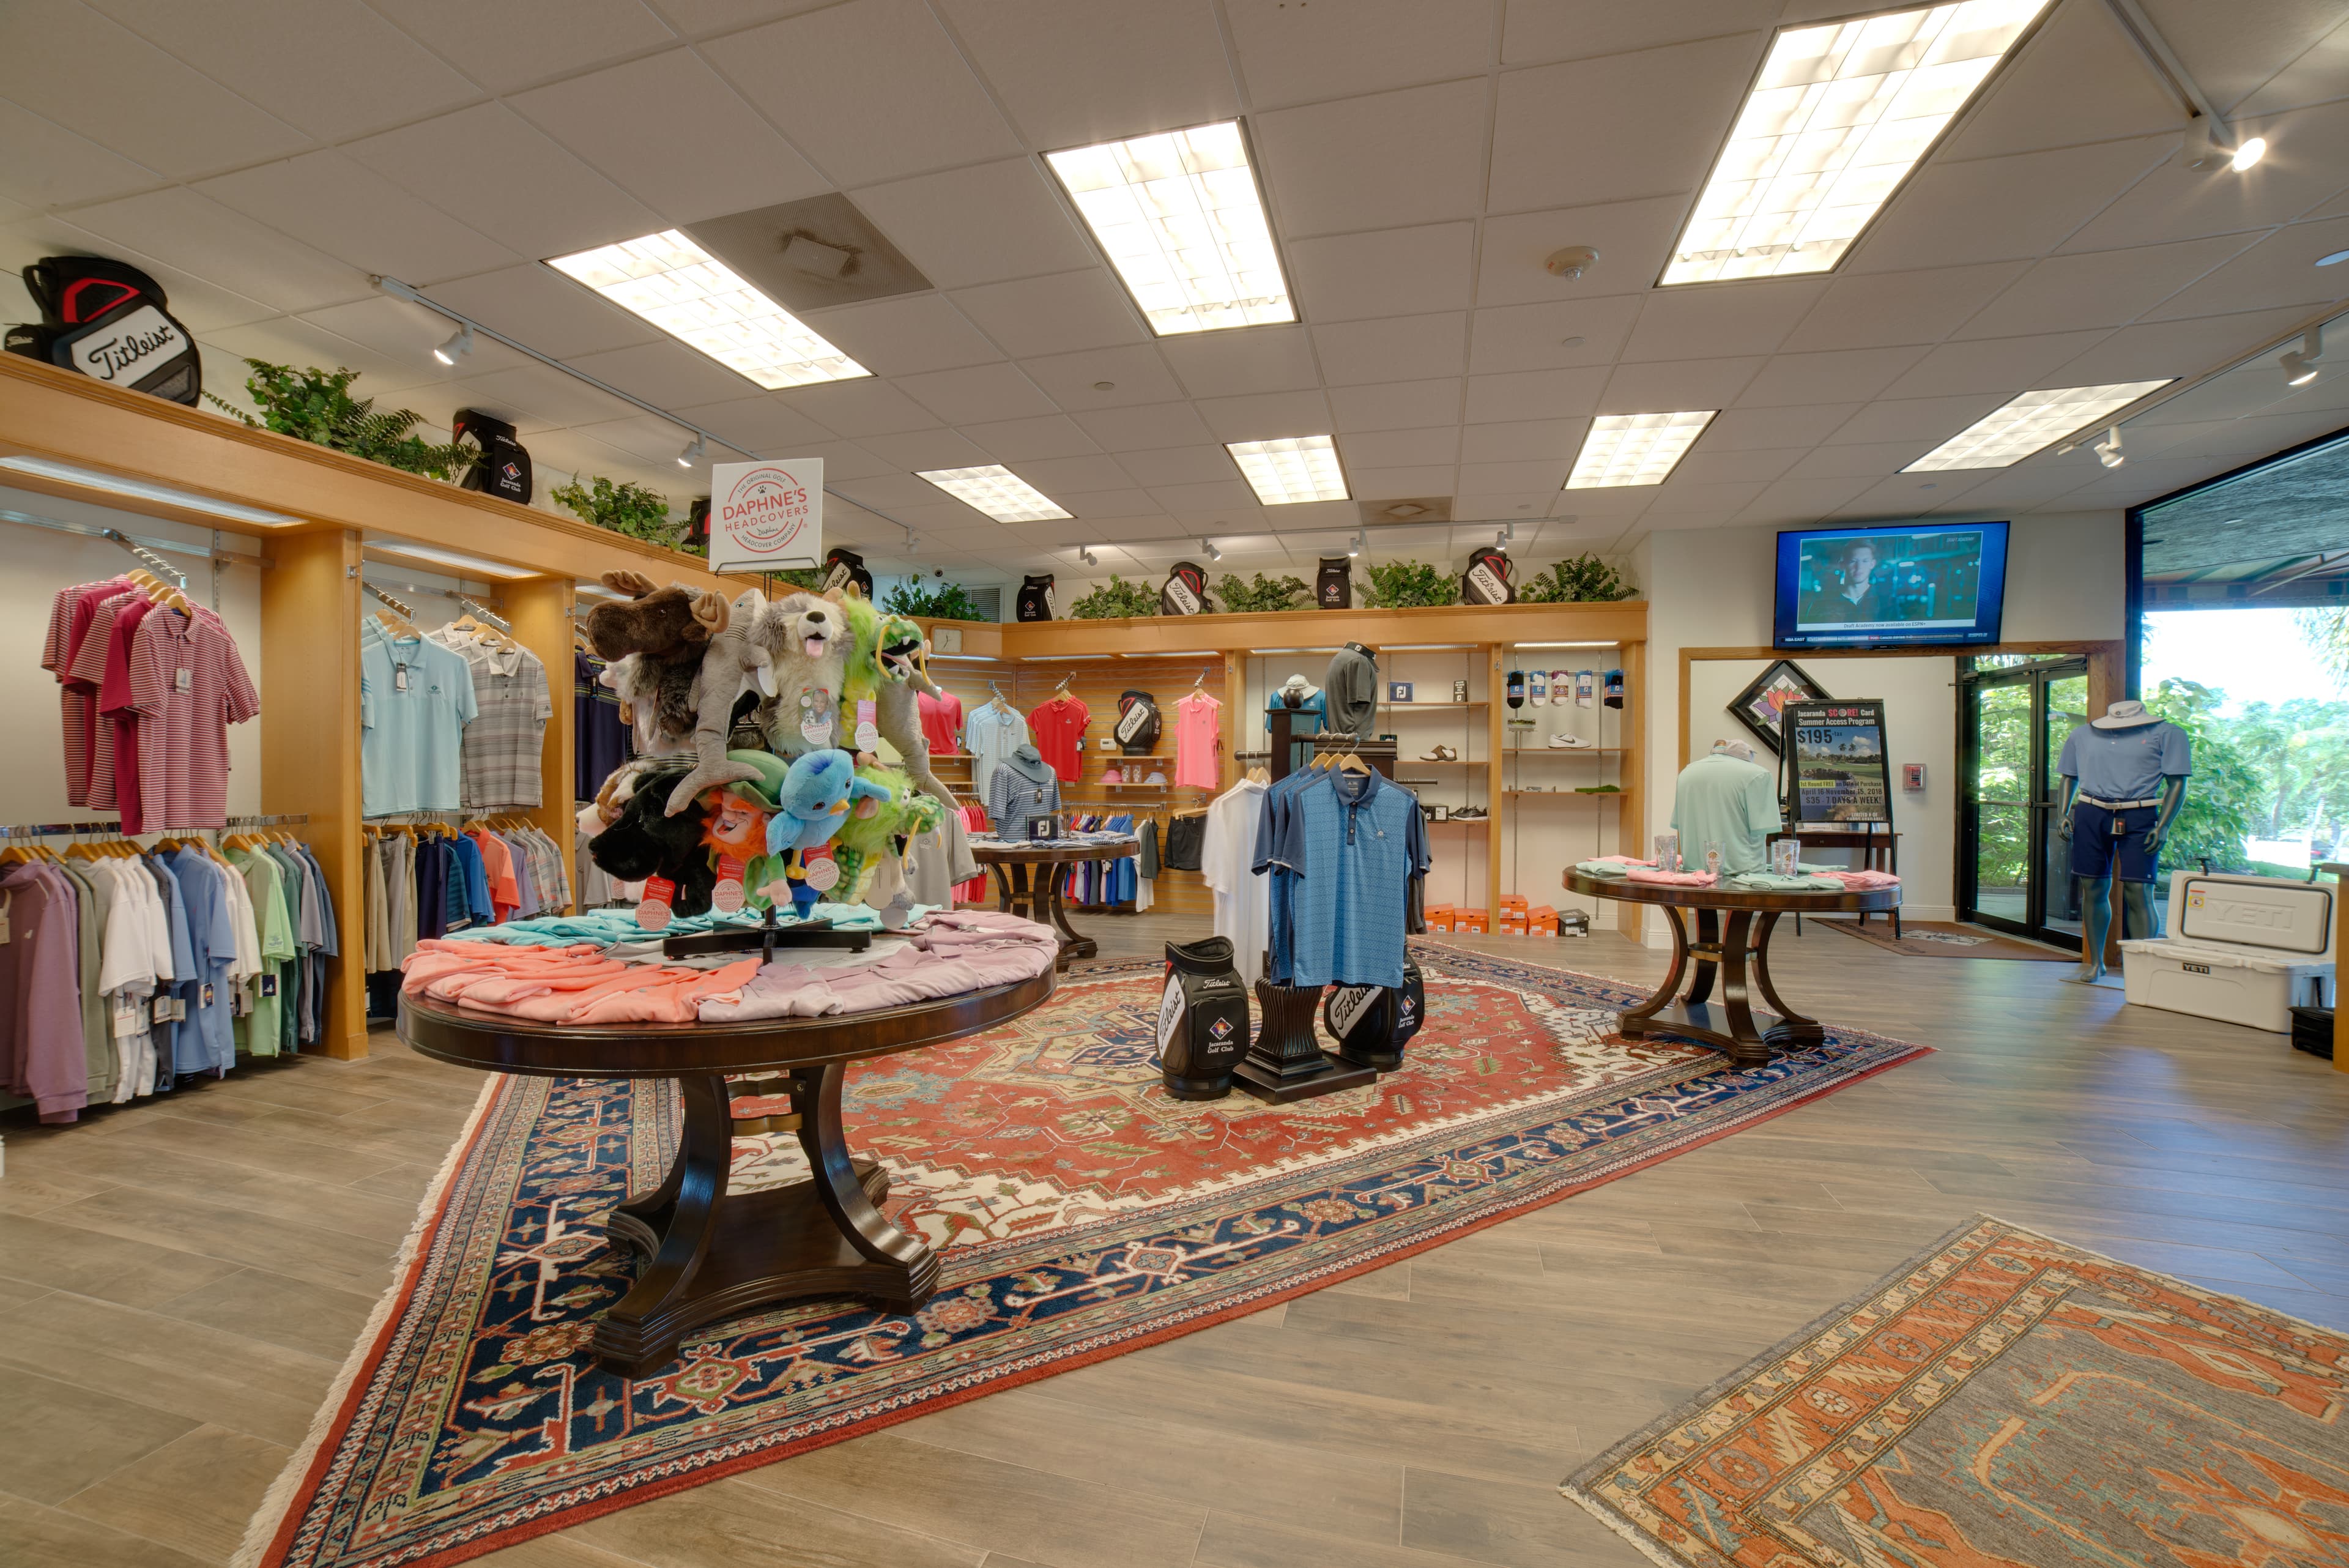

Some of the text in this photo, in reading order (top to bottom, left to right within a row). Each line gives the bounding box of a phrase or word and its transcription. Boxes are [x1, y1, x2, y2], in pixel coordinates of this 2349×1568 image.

[88, 325, 174, 380] Titleist
[738, 473, 787, 494] THE ORIGINAL GOLF
[722, 488, 807, 521] DAPHNE'S
[725, 505, 808, 532] HEADCOVERS
[741, 523, 796, 548] HEADCOVER COMPANY
[1170, 582, 1195, 615] Titleist
[1472, 569, 1502, 603] Titleist
[1396, 686, 1406, 698] FJ
[1121, 707, 1145, 738] Titleist
[1848, 718, 1875, 726] Program
[1797, 729, 1832, 744] $195
[1037, 820, 1050, 837] FJ
[2184, 963, 2208, 974] YETI
[1203, 979, 1231, 989] Titleist
[1160, 990, 1181, 1050] Titleist
[1335, 987, 1371, 1030] Titlei
[1208, 1039, 1233, 1049] Jacaranda
